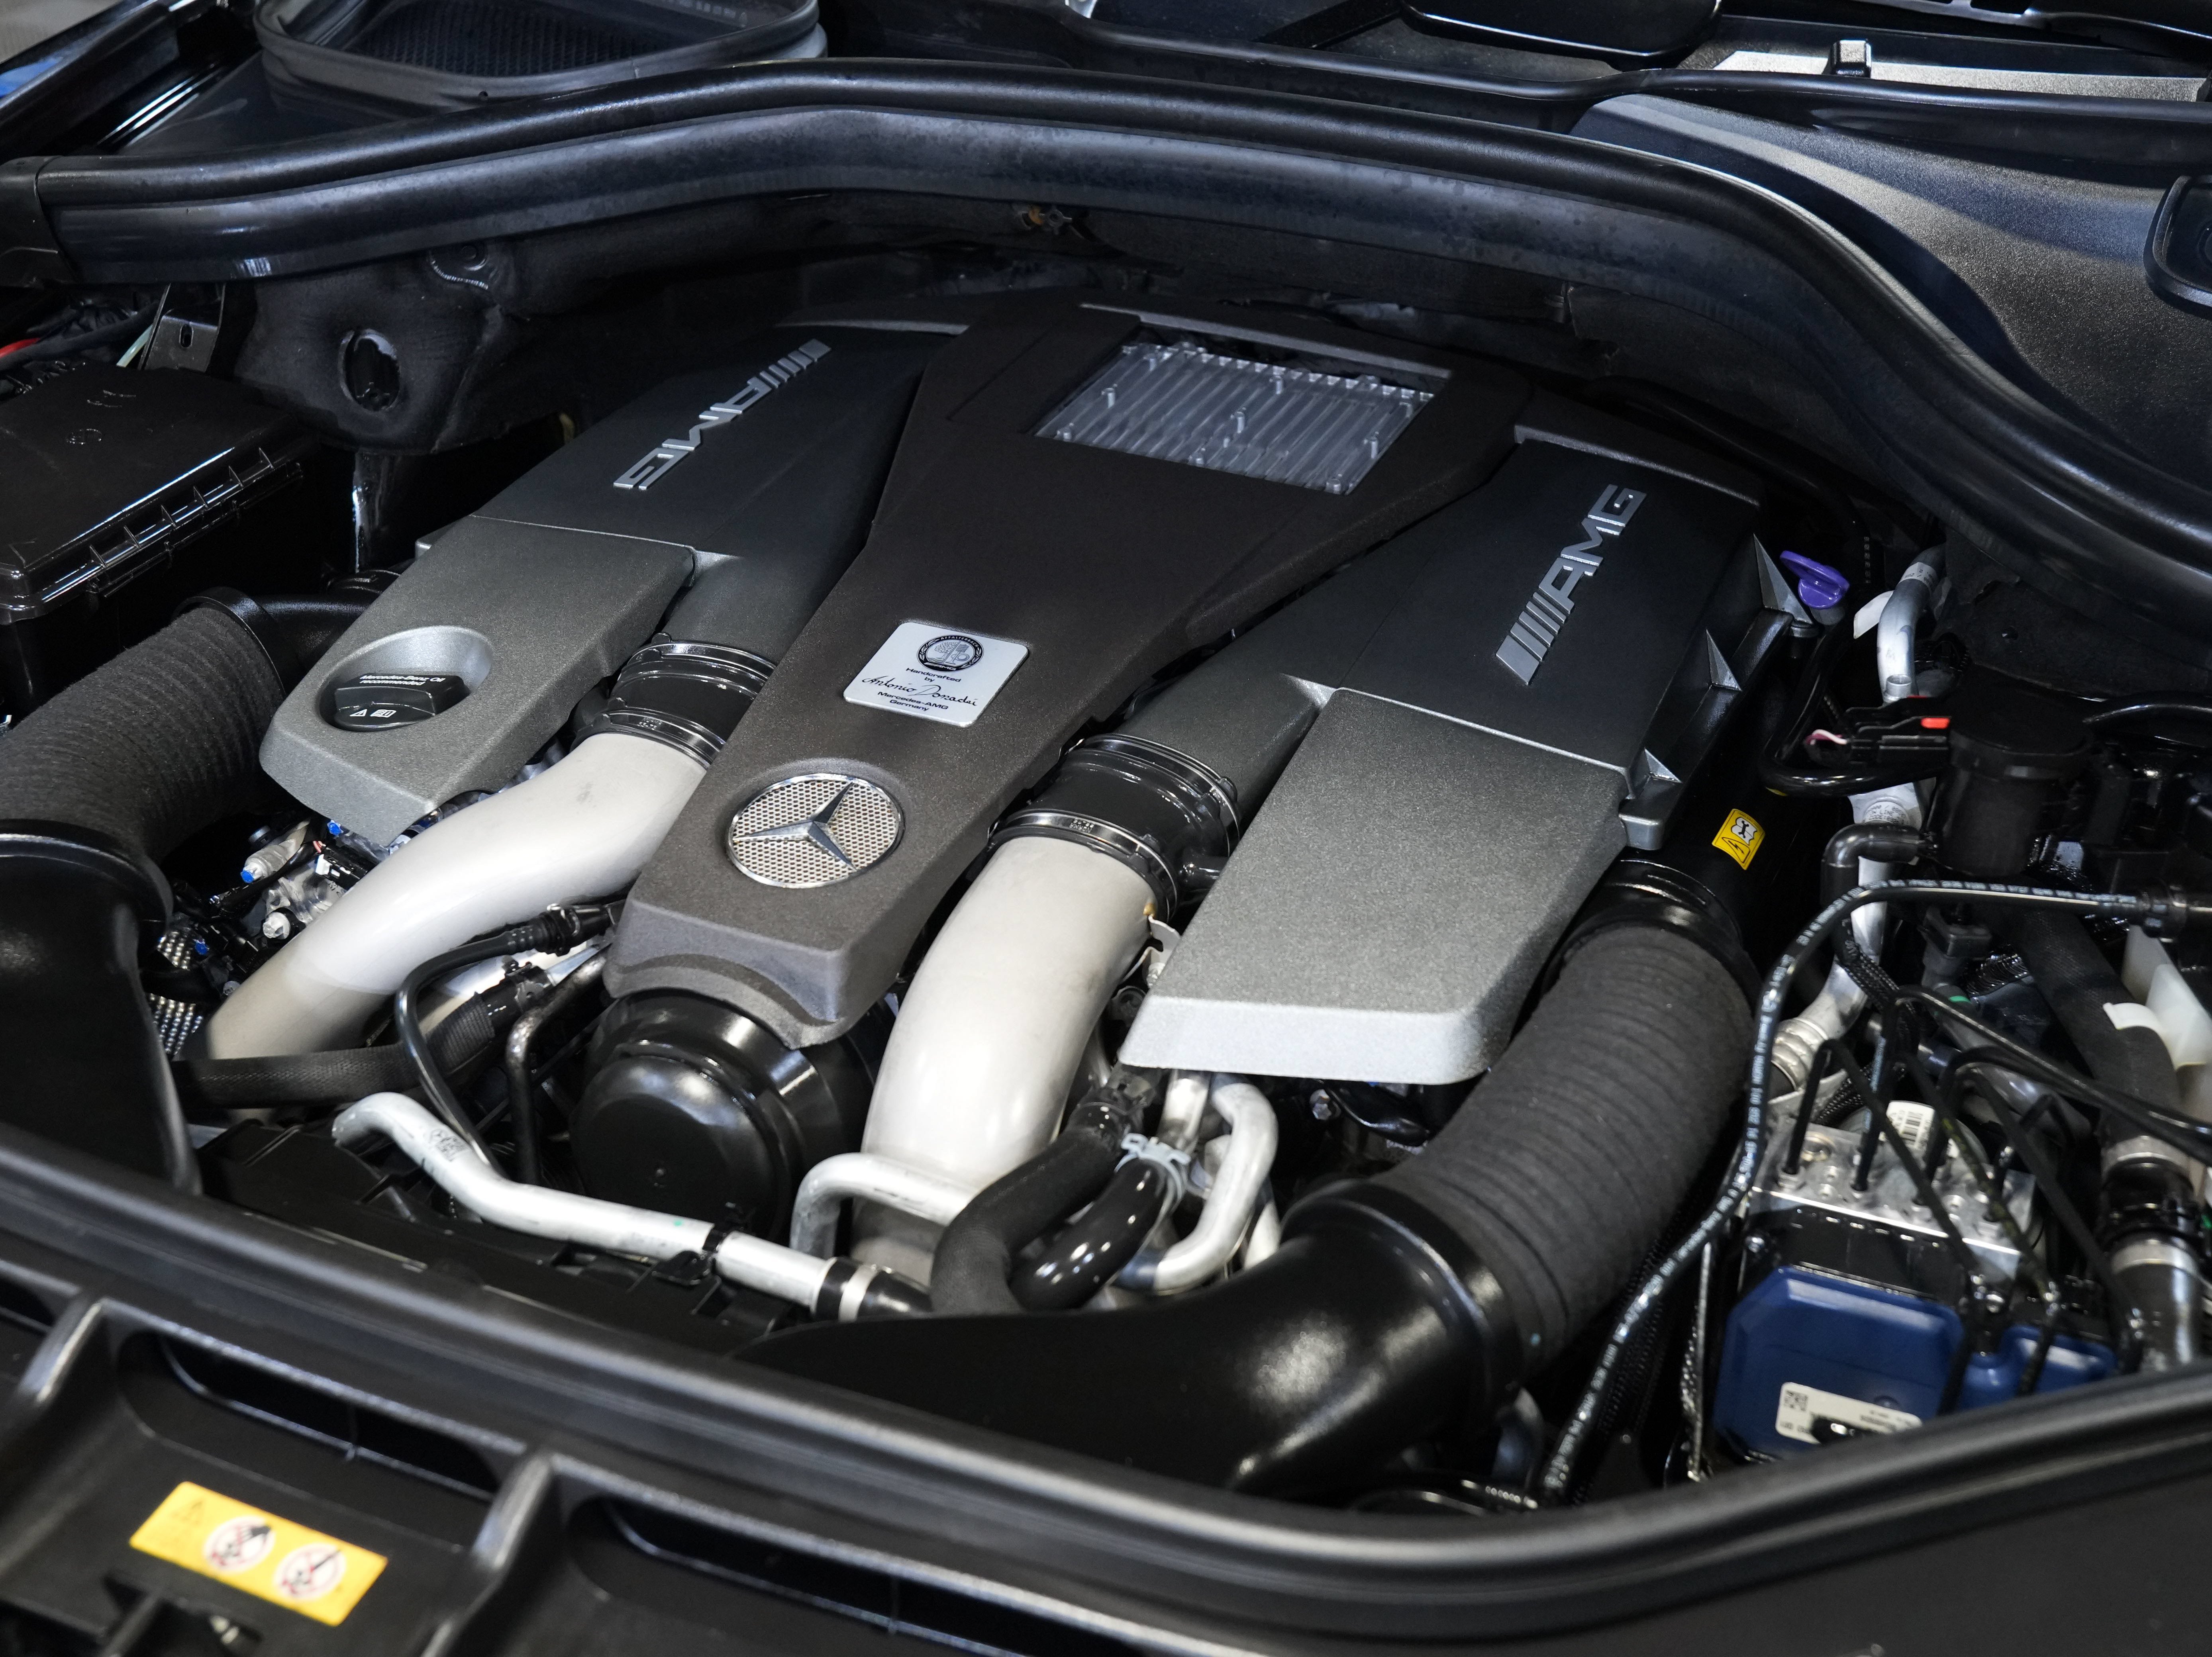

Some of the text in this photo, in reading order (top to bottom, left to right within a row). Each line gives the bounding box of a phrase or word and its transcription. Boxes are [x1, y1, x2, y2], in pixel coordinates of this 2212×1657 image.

[940, 636, 979, 647] AFFALTERBACH
[906, 668, 961, 682] Handcrafted
[862, 676, 917, 692] Antonio
[878, 691, 949, 710] Mercedes-AMG
[890, 699, 930, 711] Germany
